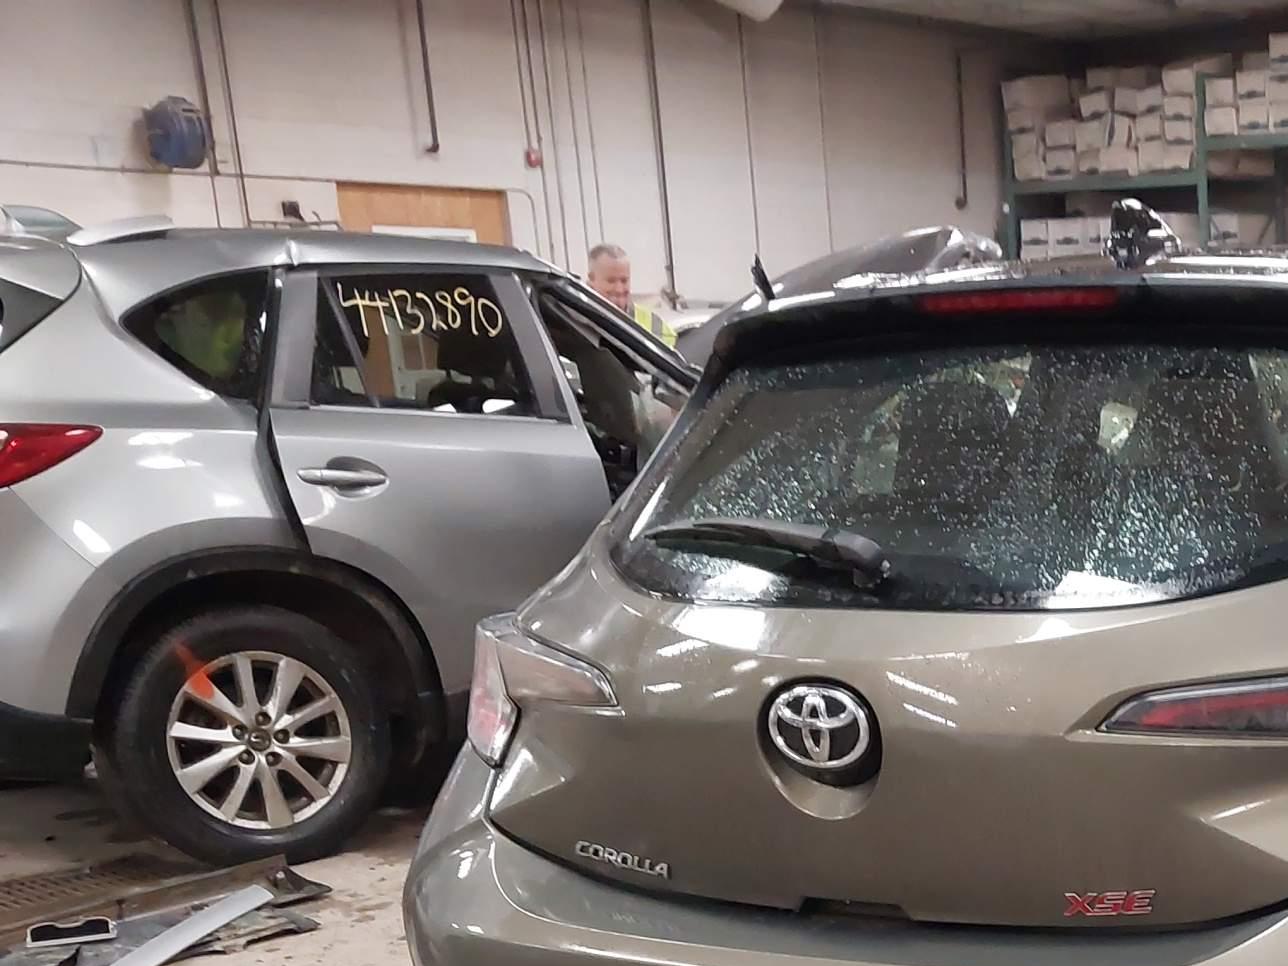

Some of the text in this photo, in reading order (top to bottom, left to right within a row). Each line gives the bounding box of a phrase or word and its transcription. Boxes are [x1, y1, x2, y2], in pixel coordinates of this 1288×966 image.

[337, 281, 503, 338] 44132890
[575, 840, 669, 879] COROLLA
[1063, 889, 1156, 917] XSE
